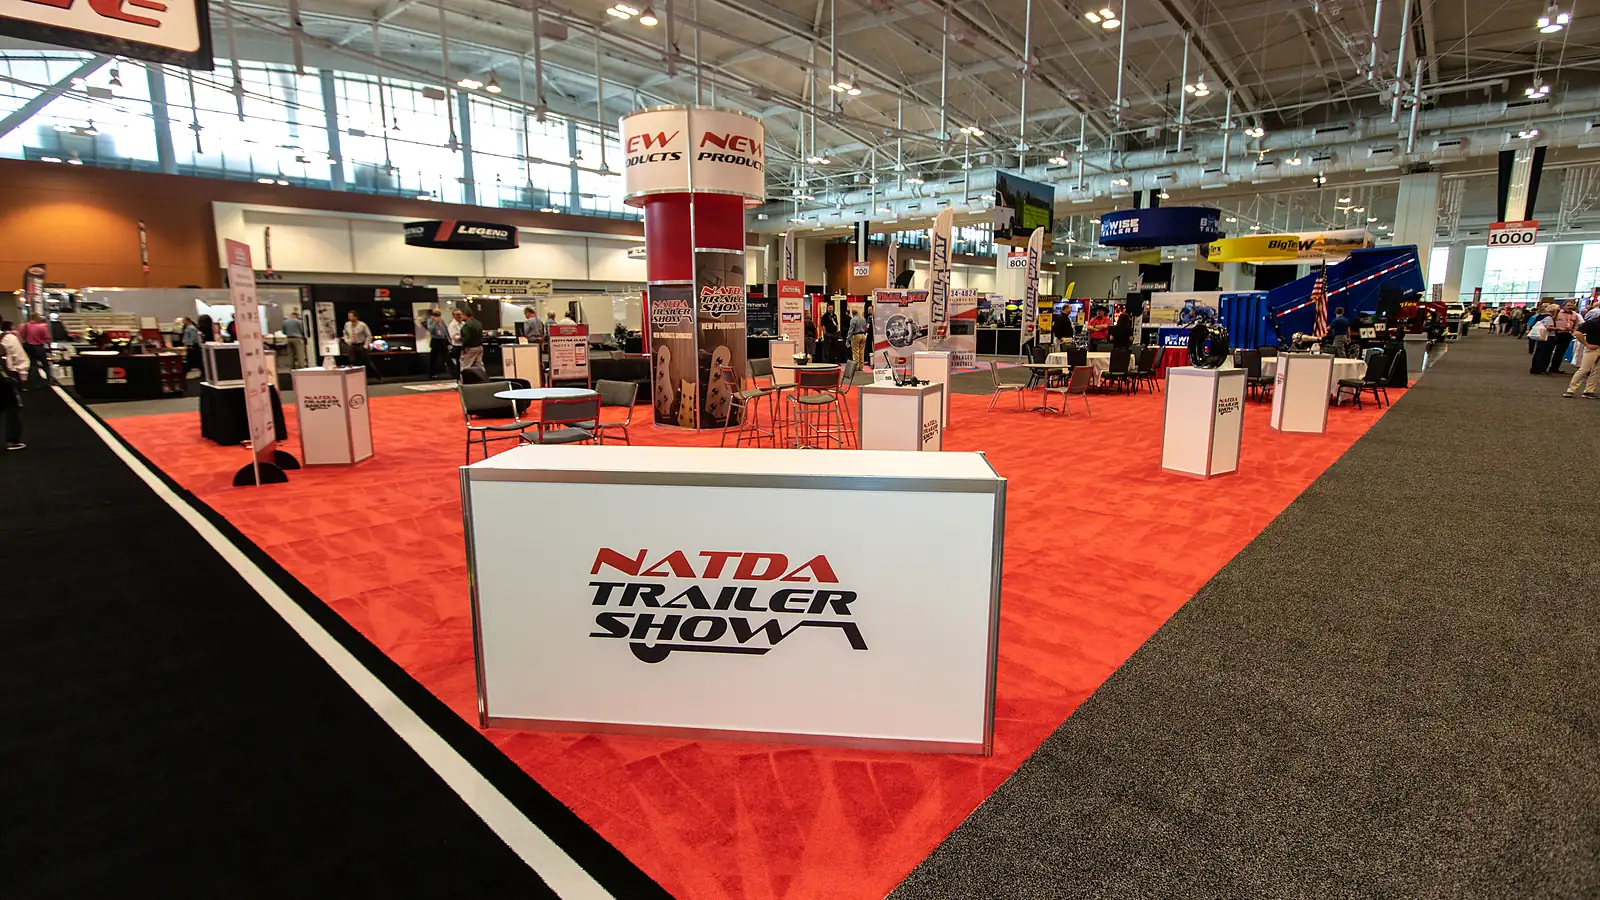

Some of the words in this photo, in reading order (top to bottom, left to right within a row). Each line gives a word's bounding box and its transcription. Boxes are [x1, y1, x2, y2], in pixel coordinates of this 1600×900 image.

[697, 152, 764, 172] PRODUCT
[457, 225, 508, 237] LEGEND
[1490, 232, 1533, 244] 1000
[653, 300, 688, 308] NATDA
[589, 547, 840, 583] NATDA
[588, 581, 858, 615] TRAILER
[588, 611, 866, 650] SHOW
